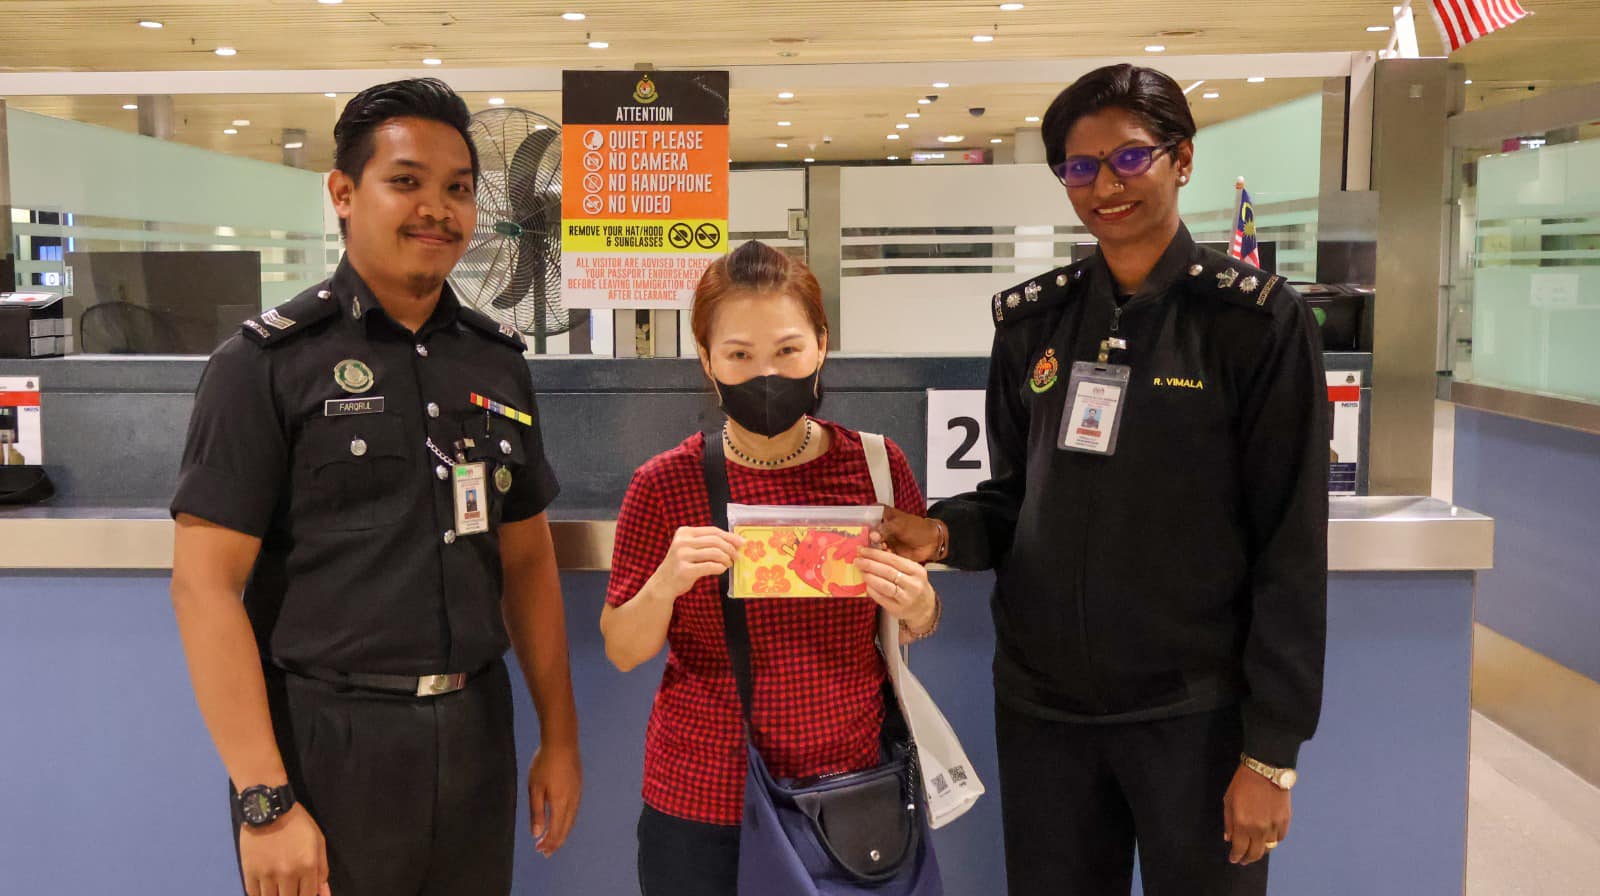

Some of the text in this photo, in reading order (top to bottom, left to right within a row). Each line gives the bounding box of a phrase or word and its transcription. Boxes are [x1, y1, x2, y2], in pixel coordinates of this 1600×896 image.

[616, 106, 673, 122] ATTENTION
[608, 130, 703, 151] QUIET PLEASE
[608, 152, 689, 171] NO CAMERA
[608, 173, 713, 193] NO HANDPHONE
[608, 195, 672, 214] NO VIDEO
[569, 225, 664, 237] REMOVE YOUR HAT/HOOD
[606, 236, 664, 247] & SUNGLASSES
[576, 258, 590, 268] ALL
[592, 258, 622, 268] VISITOR
[624, 258, 639, 268] ARE
[641, 258, 674, 268] ADVISED
[676, 258, 686, 268] TO
[585, 268, 605, 279] YOUR
[607, 268, 646, 279] PASSPORT
[568, 279, 597, 289] BEFORE
[598, 279, 631, 289] LEAVING
[633, 279, 685, 290] IMMIGRATION
[608, 289, 631, 300] AFTER
[1153, 377, 1204, 390] R. VIMALA
[946, 416, 982, 469] 2
